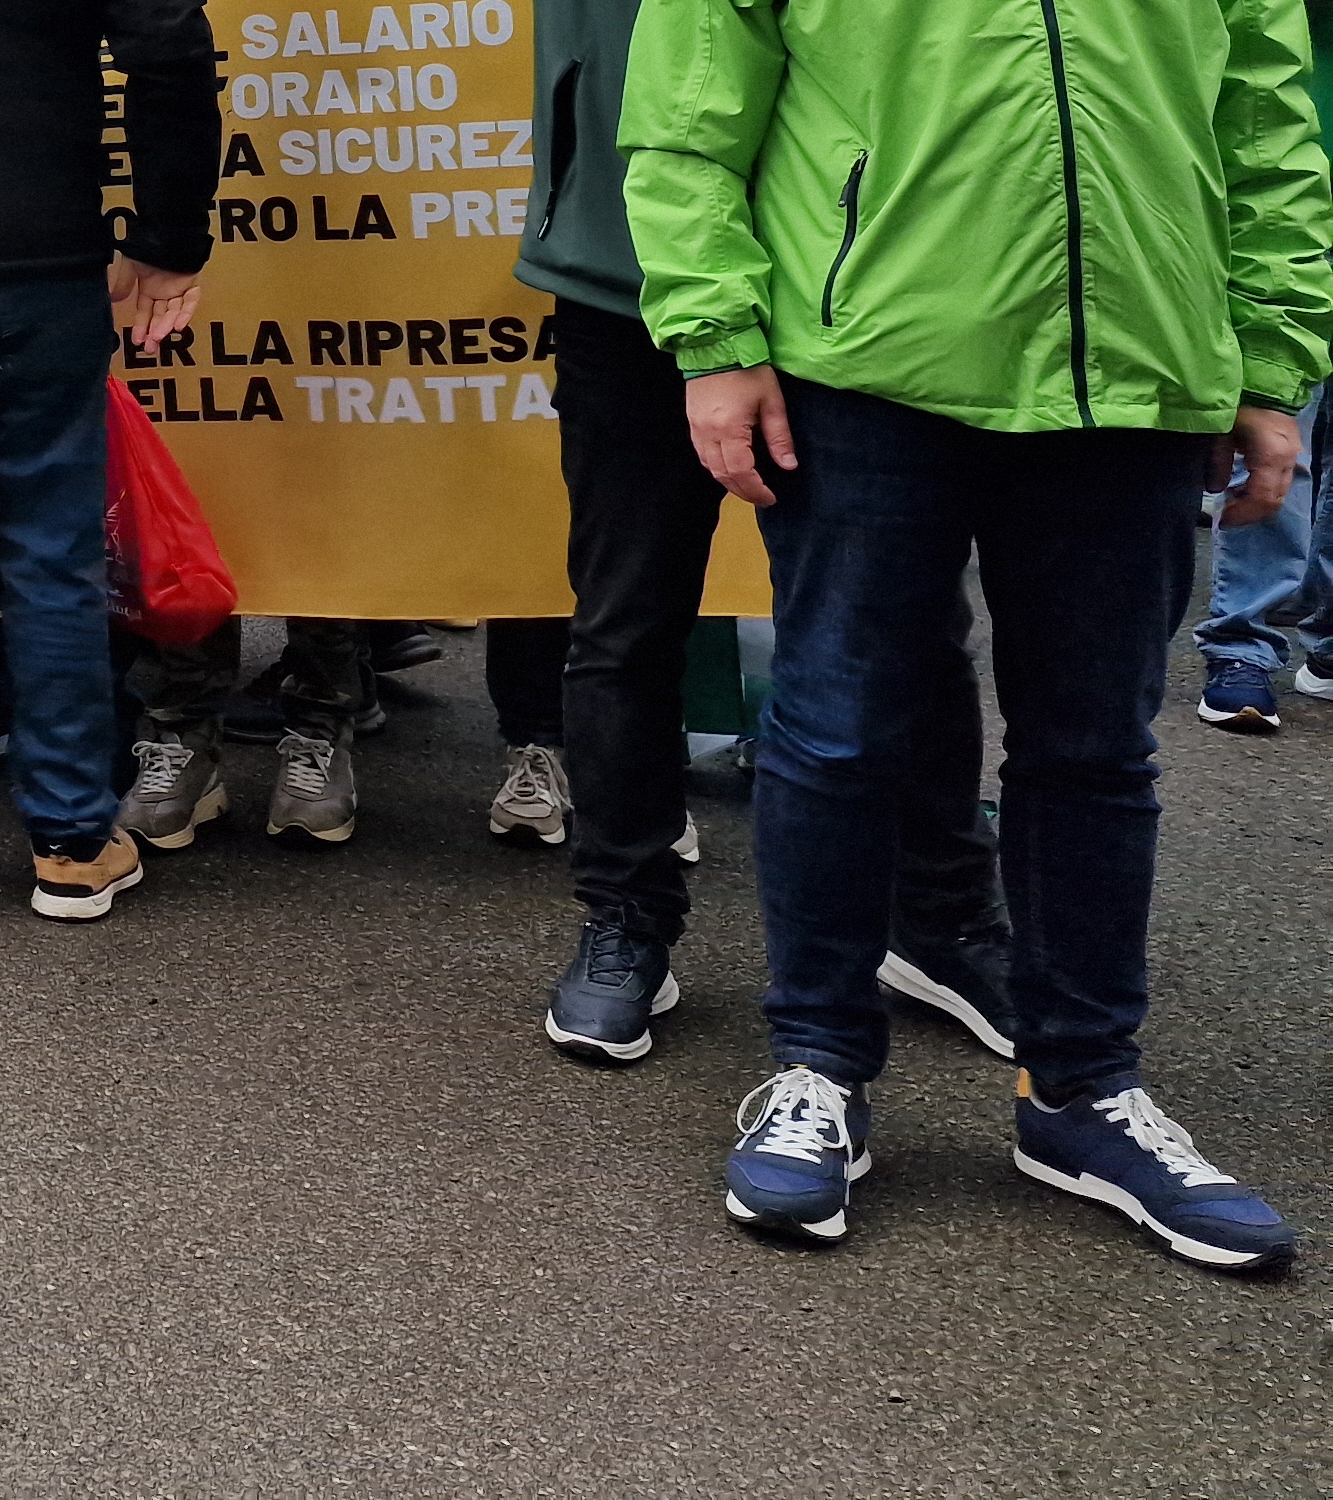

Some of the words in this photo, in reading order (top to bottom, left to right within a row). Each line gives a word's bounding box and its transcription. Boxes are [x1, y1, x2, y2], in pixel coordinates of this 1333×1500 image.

[221, 133, 266, 178] A
[278, 119, 533, 176] SICUREZ
[312, 194, 397, 241] LA
[410, 188, 530, 240] PRE
[209, 320, 295, 367] LA
[125, 376, 285, 423] ELLA
[294, 372, 560, 424] TRATTA
